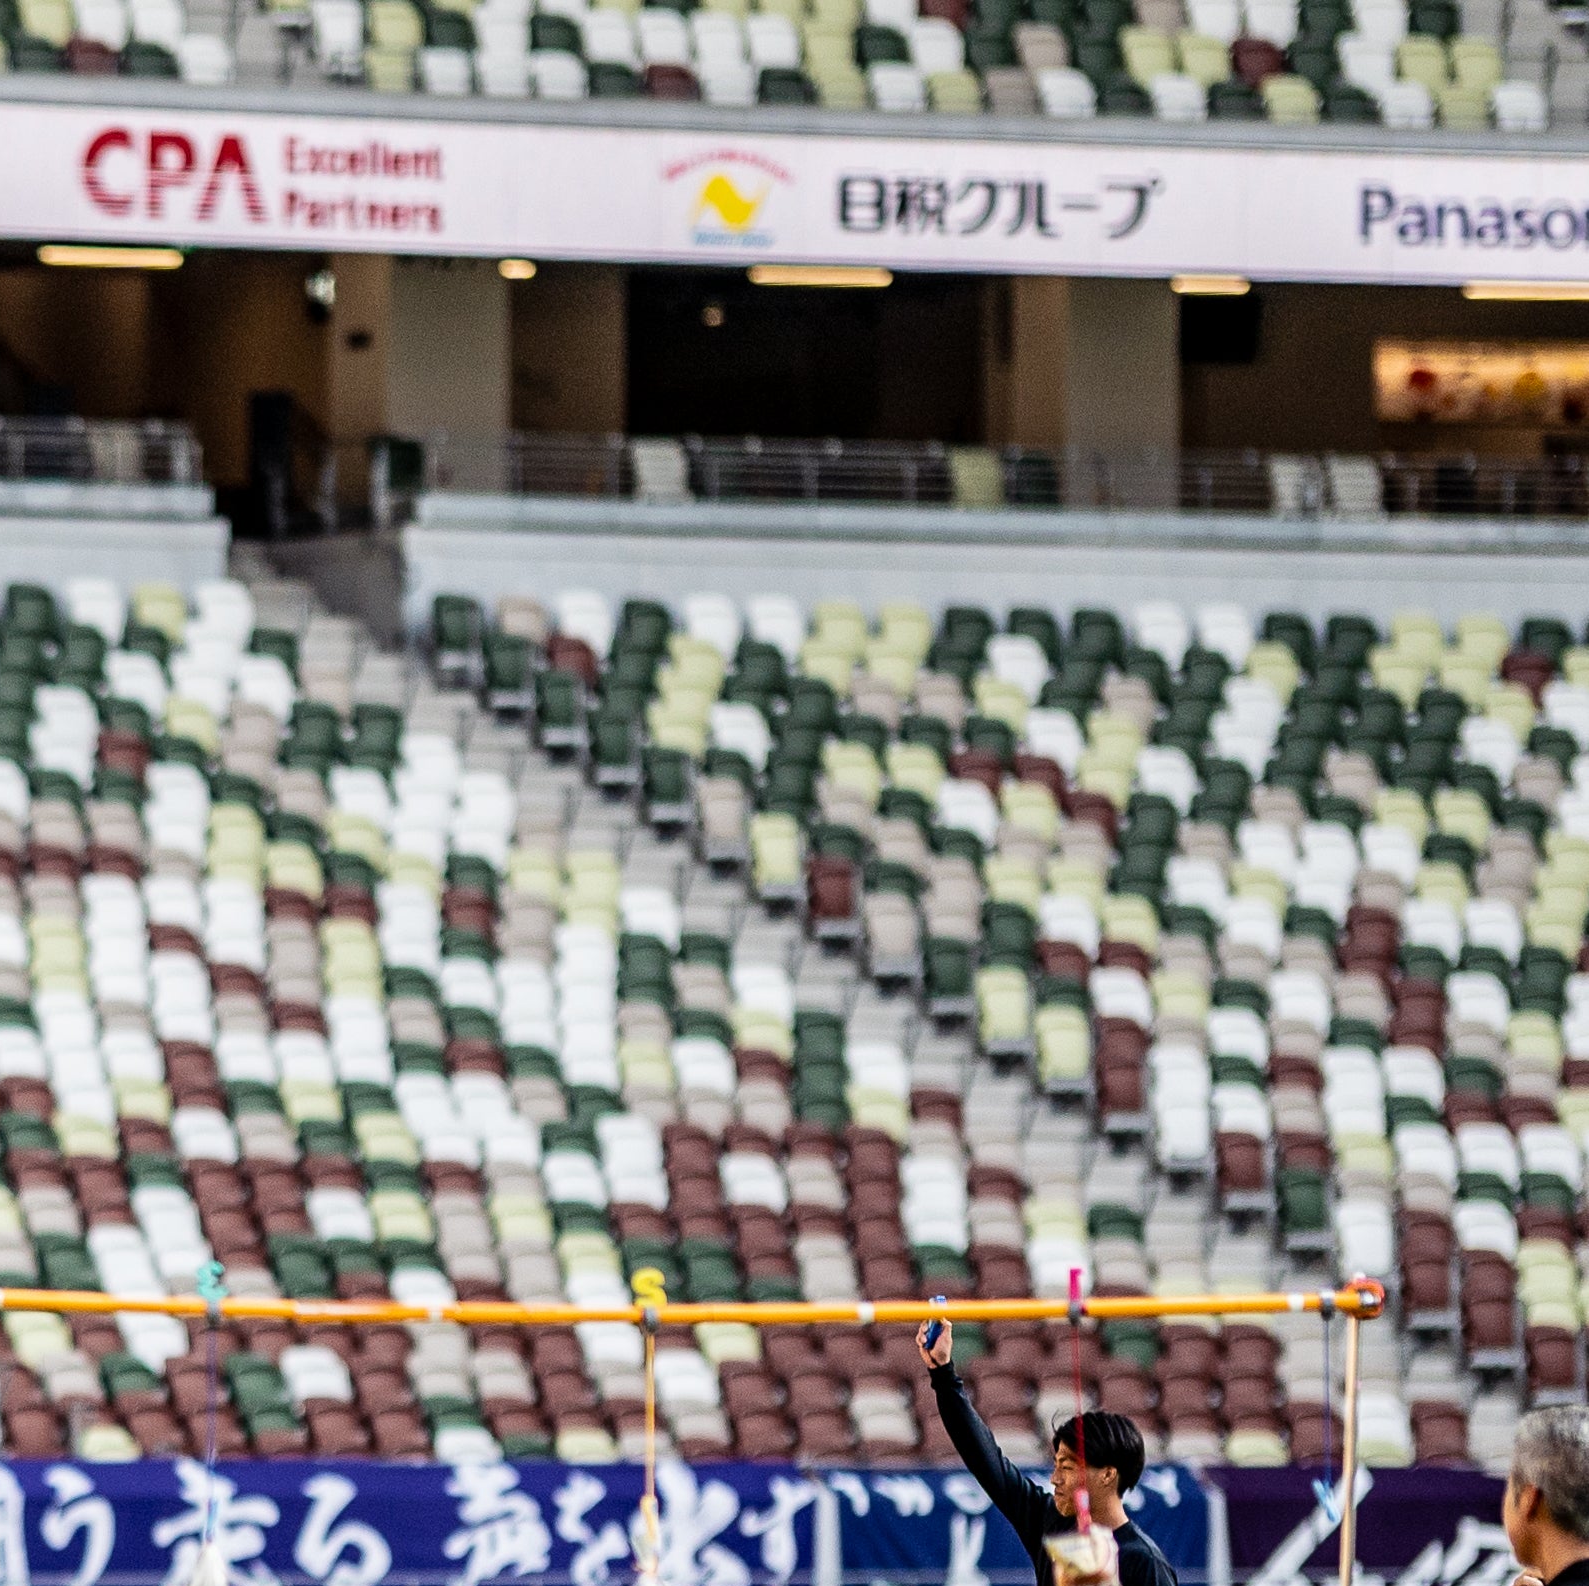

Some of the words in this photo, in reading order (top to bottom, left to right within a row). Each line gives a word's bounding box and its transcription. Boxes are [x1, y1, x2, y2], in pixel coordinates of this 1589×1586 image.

[80, 128, 267, 223] CPA
[282, 137, 444, 182] Excellent
[282, 189, 444, 234] Partners
[837, 174, 1165, 239] 日税グループ
[1360, 183, 1589, 250] Panaso
